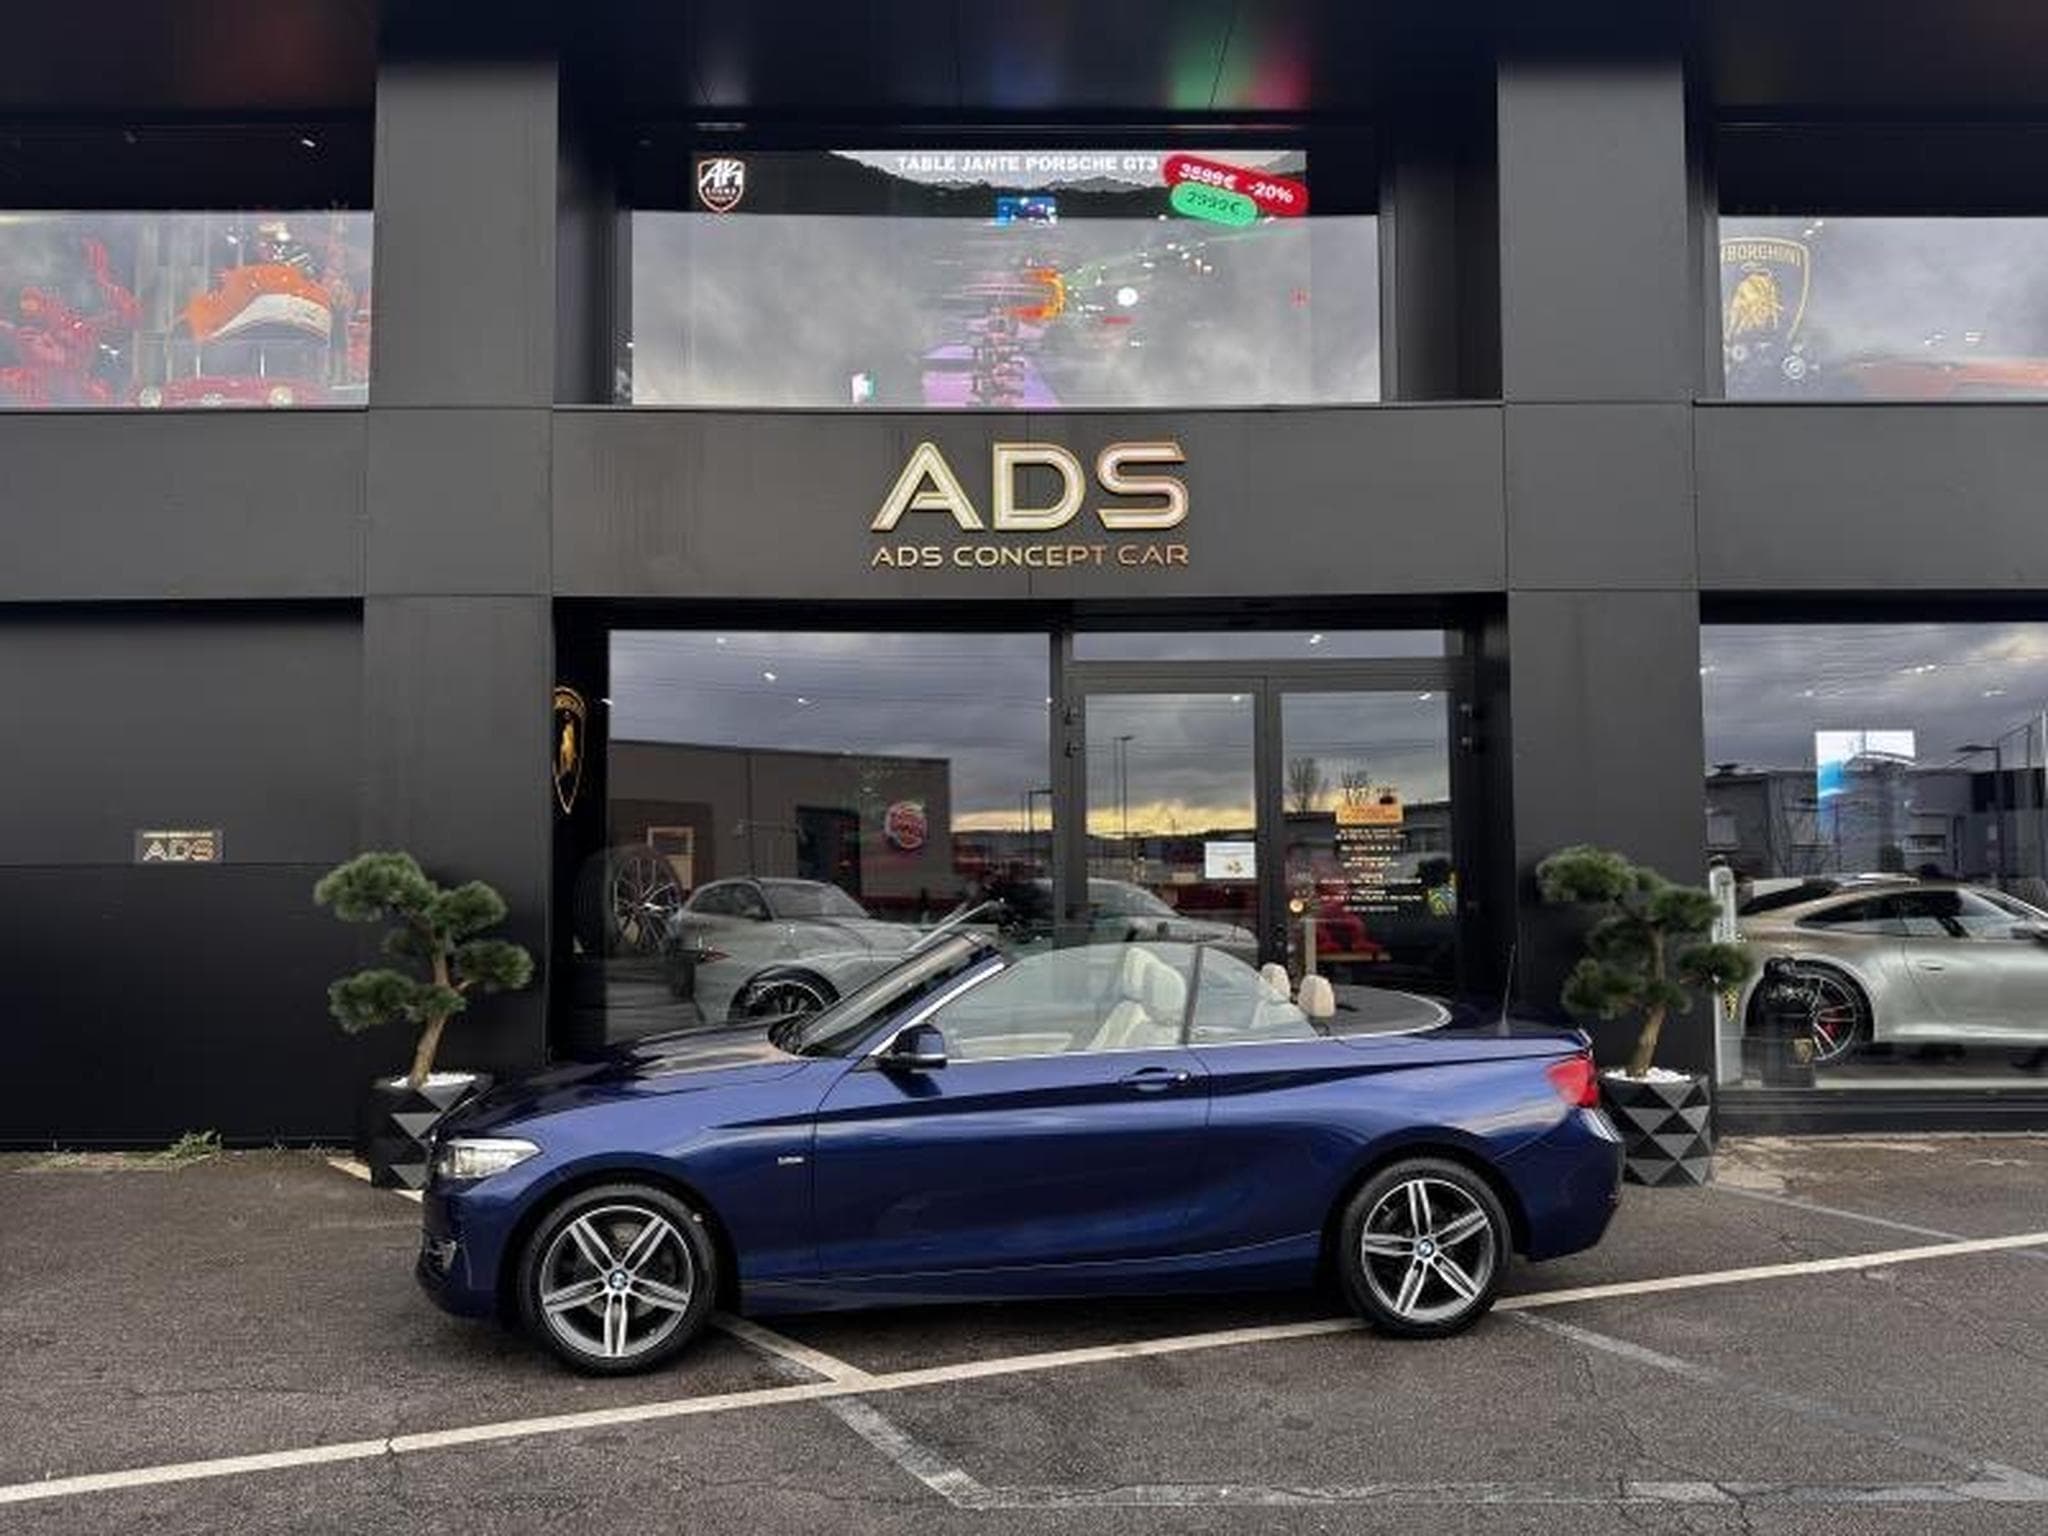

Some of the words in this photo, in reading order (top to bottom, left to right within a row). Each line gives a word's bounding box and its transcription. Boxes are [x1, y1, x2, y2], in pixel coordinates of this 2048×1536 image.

[897, 156, 957, 172] TABLE
[962, 156, 1021, 172] JANTE
[1026, 156, 1117, 172] PORSCHE
[1122, 156, 1159, 172] GT3
[1247, 180, 1295, 205] -20%
[1721, 243, 1801, 267] BORGHINI
[870, 440, 1190, 532] ADS
[871, 546, 944, 568] ADS
[953, 545, 1106, 568] CONCEPT
[1117, 543, 1190, 566] CAR
[142, 838, 215, 862] ADS
